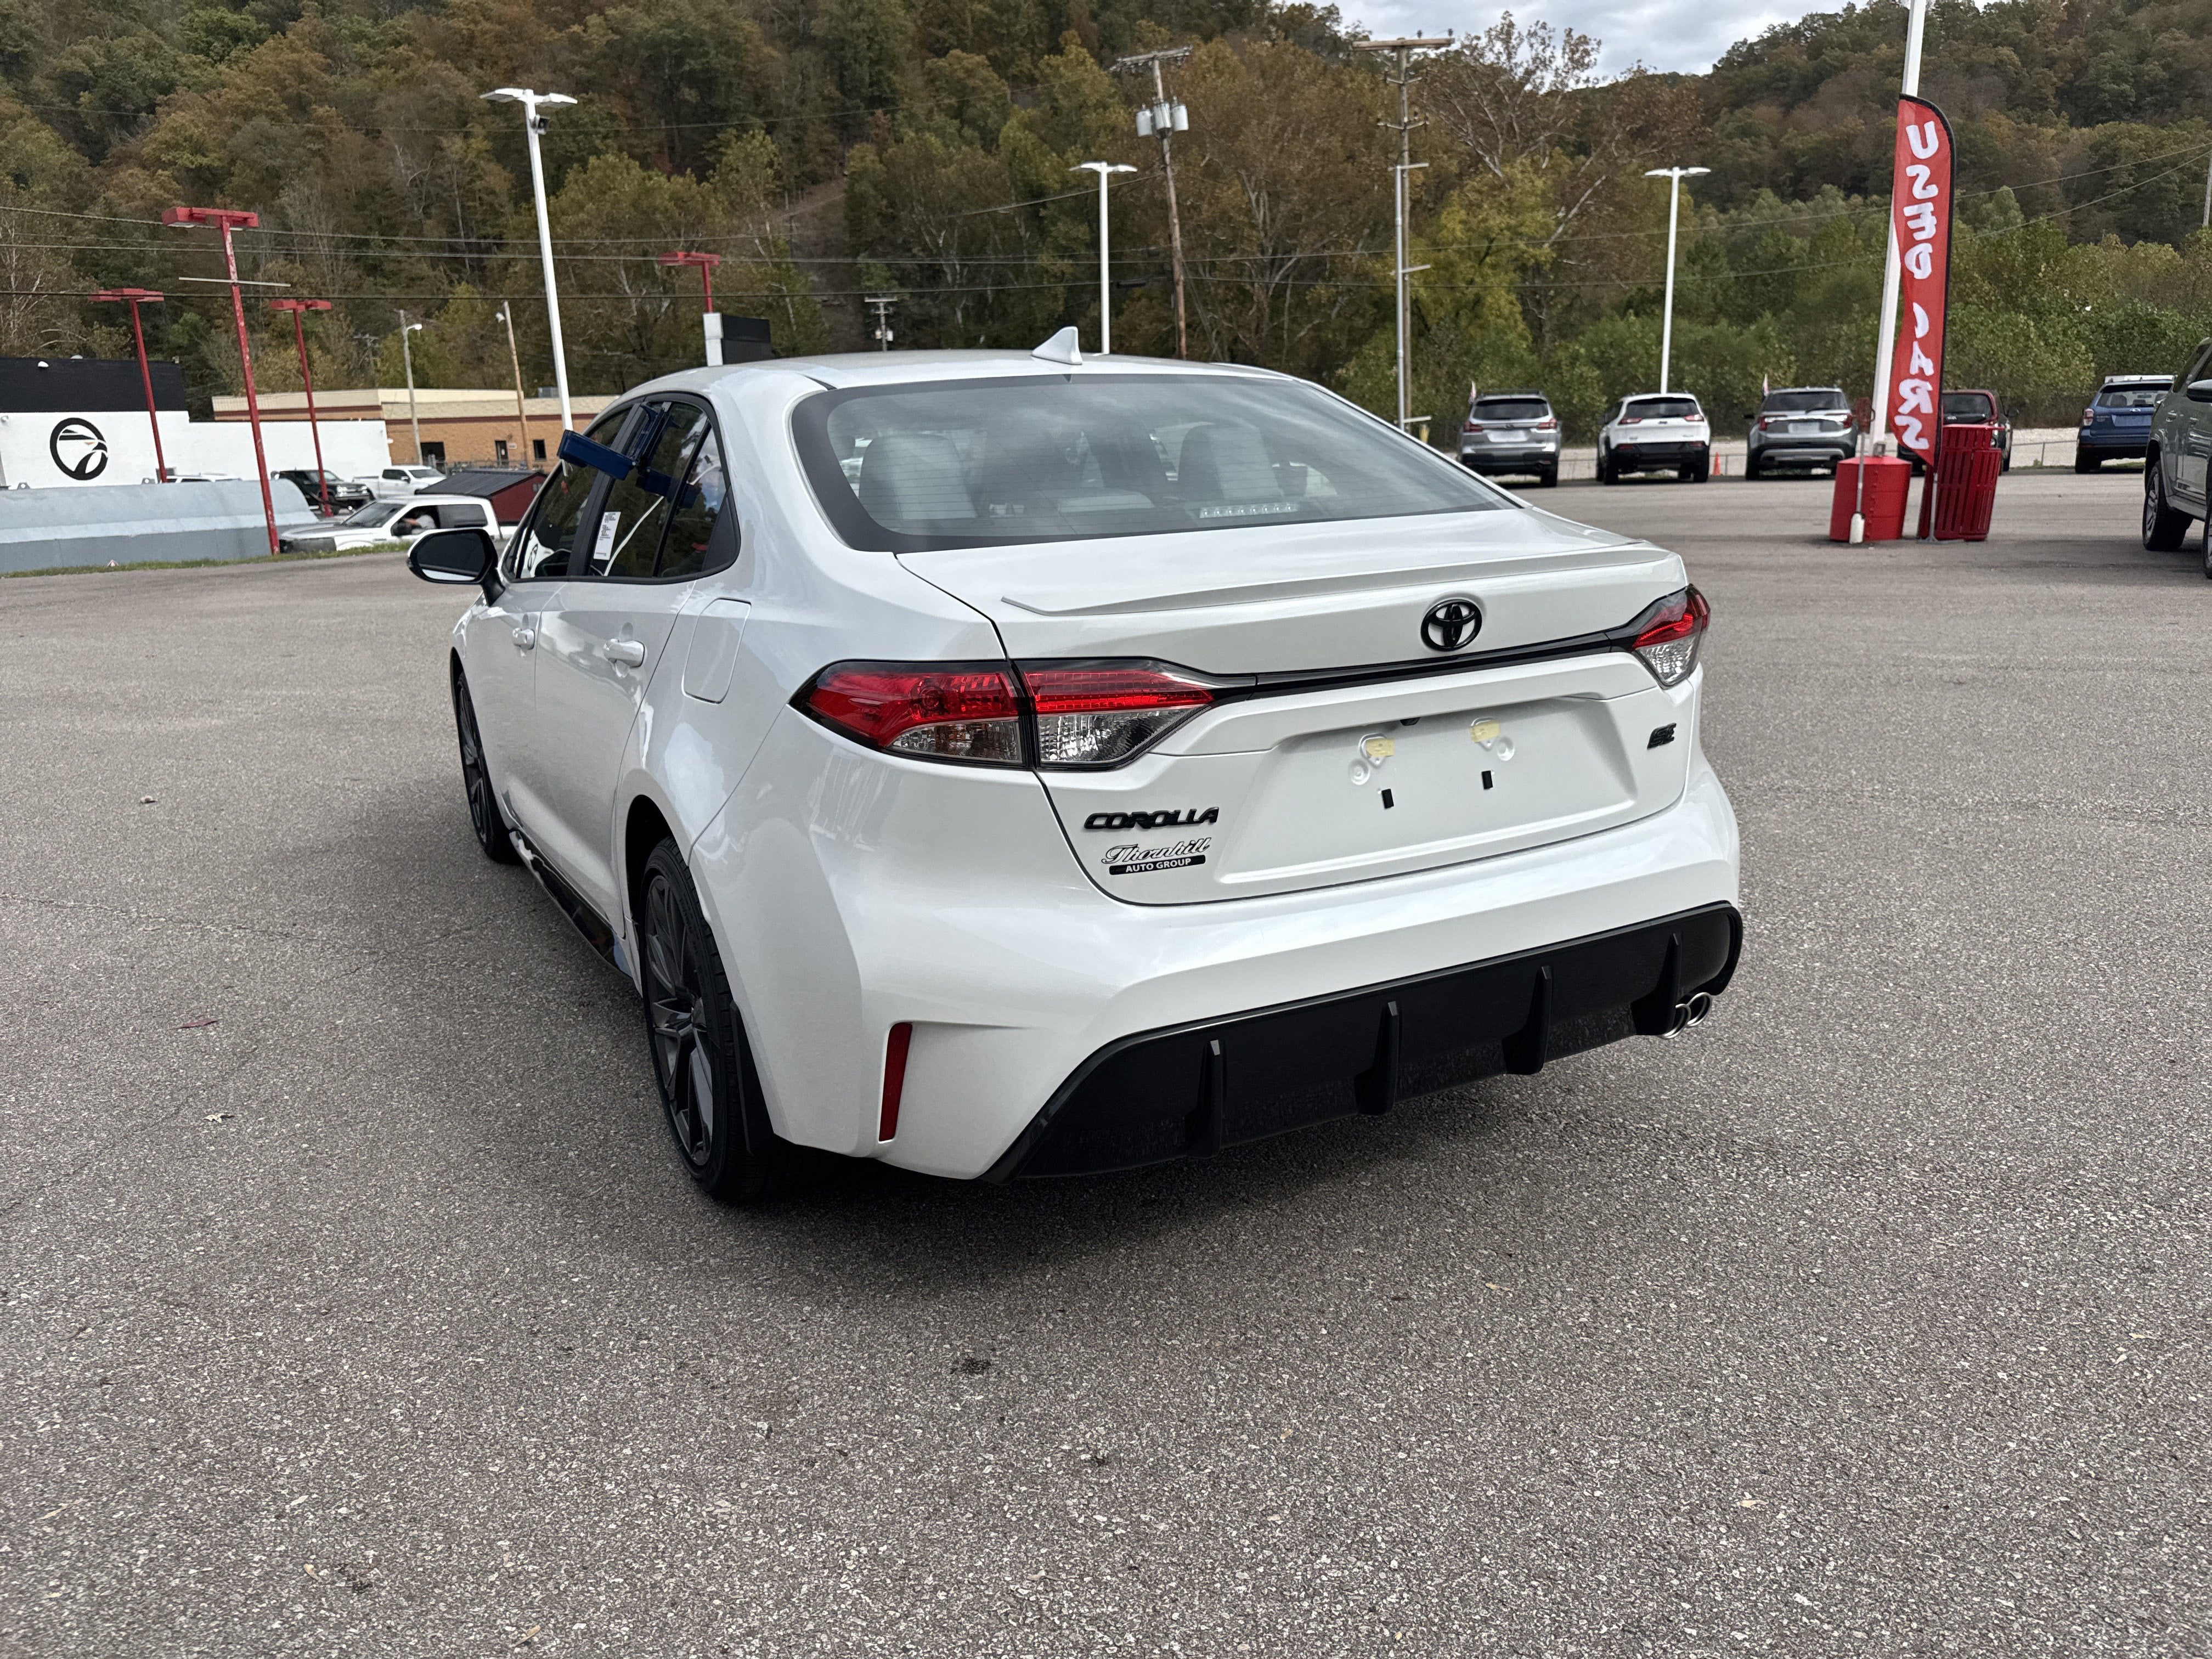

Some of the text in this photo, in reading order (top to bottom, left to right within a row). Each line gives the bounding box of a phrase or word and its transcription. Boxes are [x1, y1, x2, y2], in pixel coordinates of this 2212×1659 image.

[1084, 806, 1219, 829] COROLLA
[1101, 837, 1211, 864] Thornhill
[1126, 858, 1191, 873] AUTO GROUP
